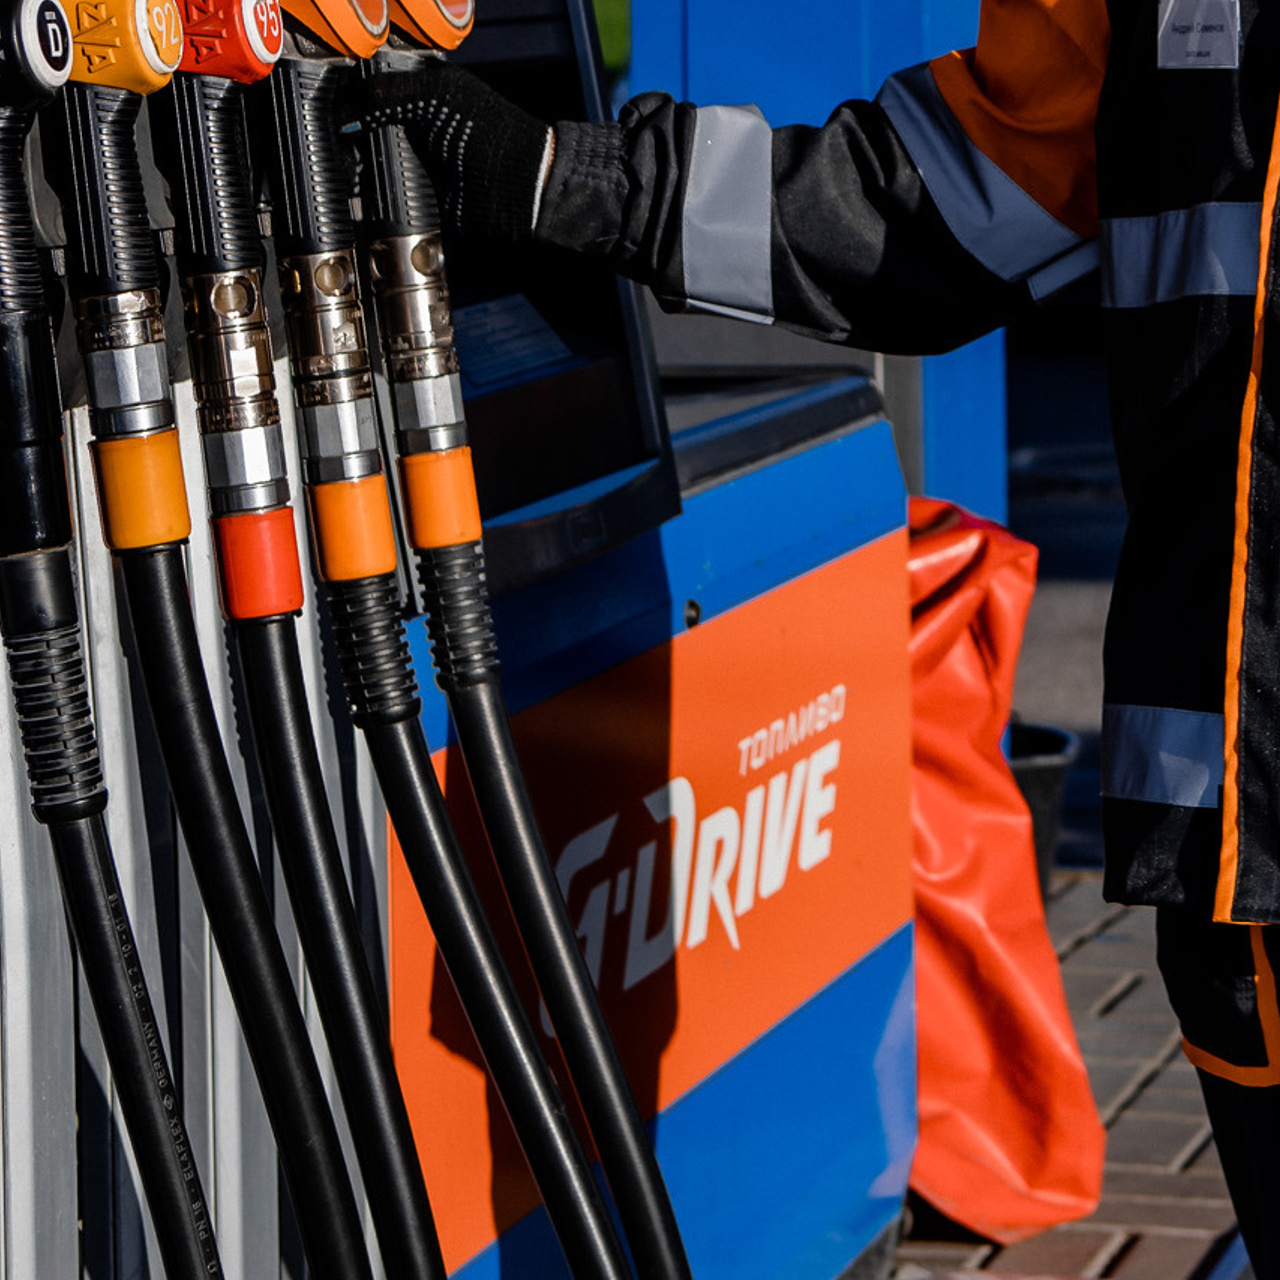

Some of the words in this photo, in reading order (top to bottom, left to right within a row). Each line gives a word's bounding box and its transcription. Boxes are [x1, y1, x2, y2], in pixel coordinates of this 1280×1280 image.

[152, 2, 180, 49] 92
[737, 683, 847, 777] ТОПЛИВО
[143, 1021, 168, 1088] GERMANY
[169, 1115, 195, 1181] ELAFLEX
